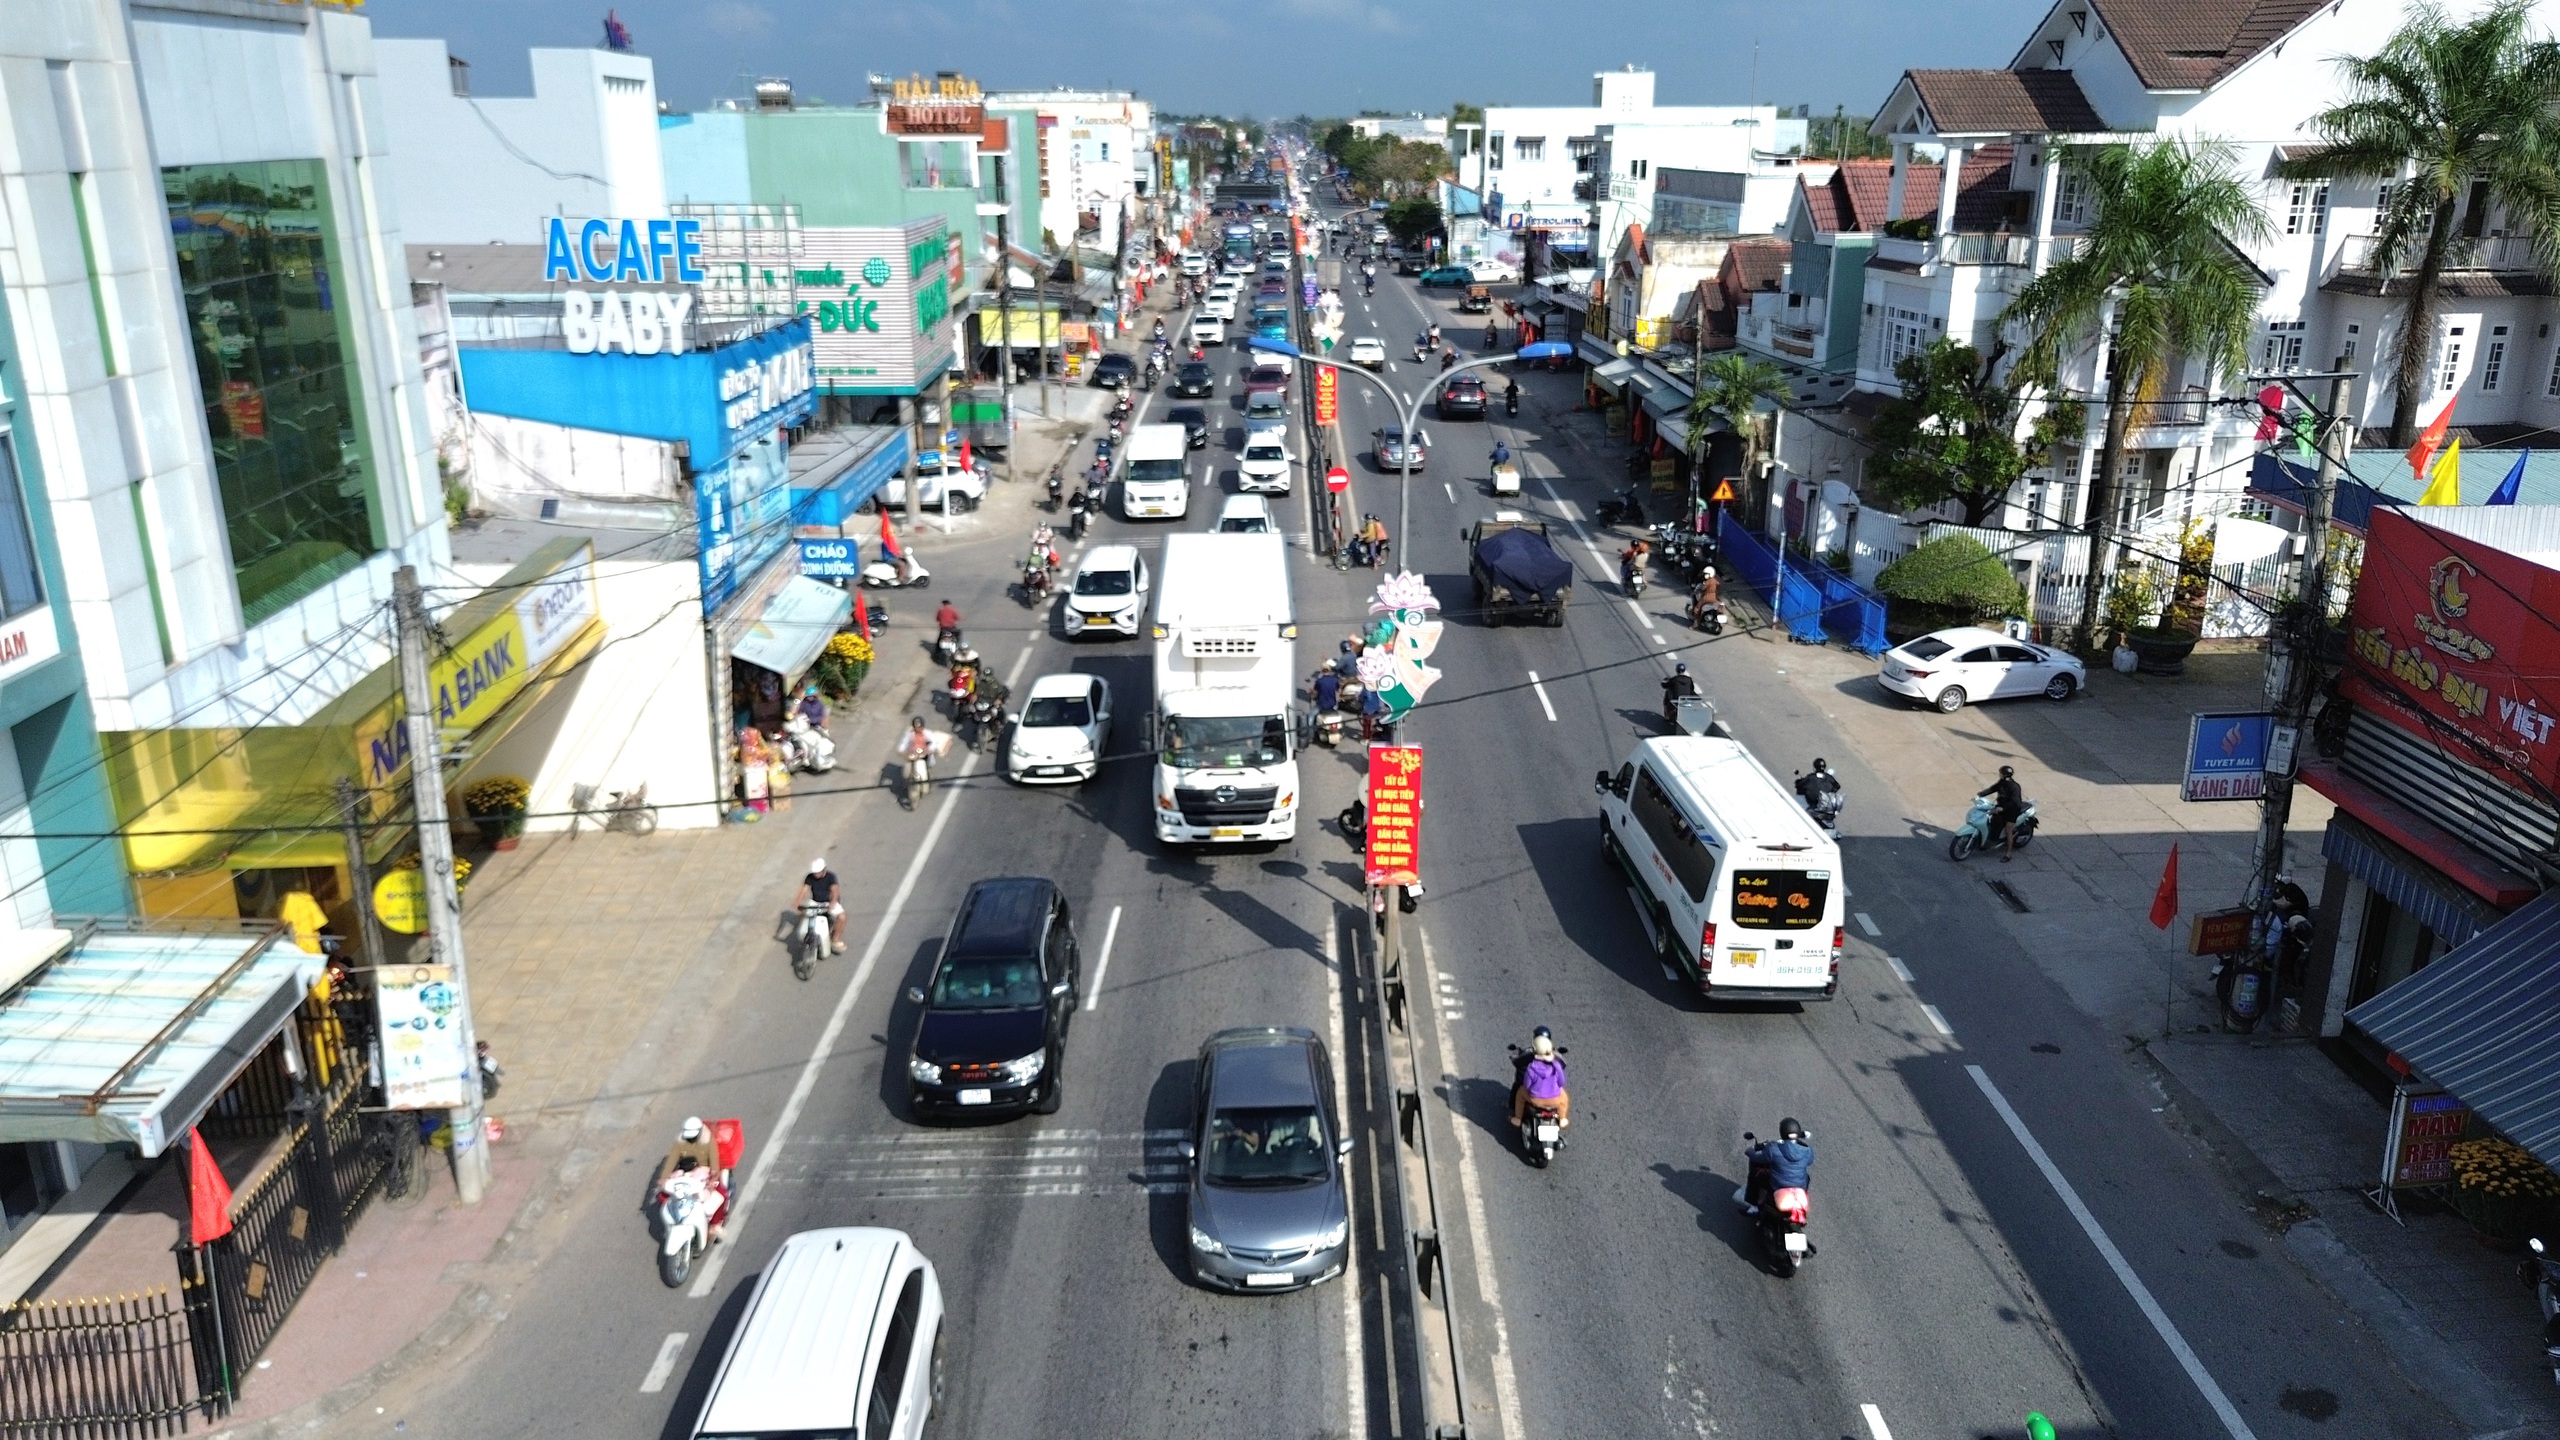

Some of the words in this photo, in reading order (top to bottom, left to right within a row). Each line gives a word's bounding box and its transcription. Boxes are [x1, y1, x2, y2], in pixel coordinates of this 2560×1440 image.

[906, 107, 971, 125] HOTEL
[819, 284, 880, 333] ĐỨC
[563, 289, 693, 356] BABY
[805, 541, 848, 560] CHÁO
[455, 630, 516, 716] BANK
[2499, 695, 2557, 746] VIỆT
[2236, 757, 2254, 766] MAI
[2191, 775, 2229, 798] XĂNG
[2232, 771, 2261, 797] DẦU
[2407, 1112, 2464, 1138] MÀN
